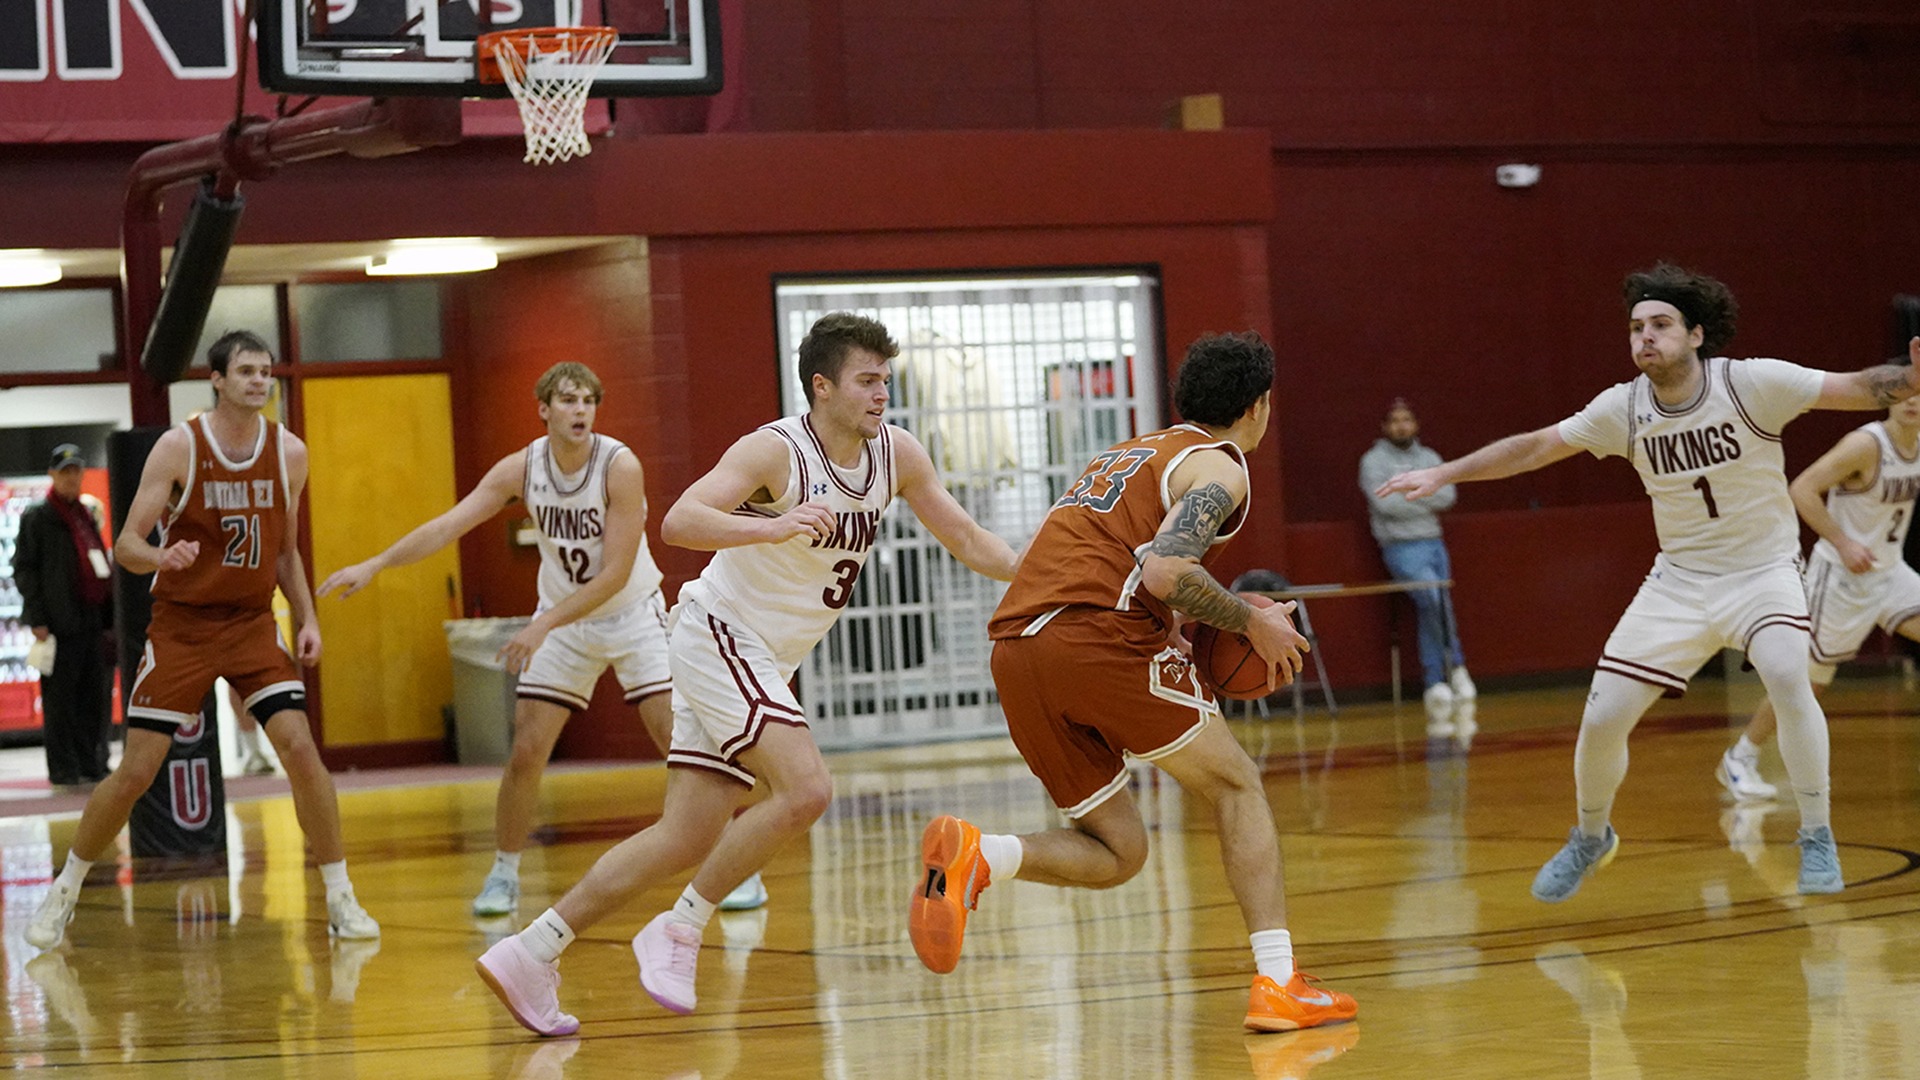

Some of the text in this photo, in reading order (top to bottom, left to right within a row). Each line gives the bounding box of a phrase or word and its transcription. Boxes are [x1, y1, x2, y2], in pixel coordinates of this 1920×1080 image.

[1643, 422, 1742, 476] VIKINGS
[1054, 448, 1157, 513] 33
[1692, 475, 1720, 519] 1
[221, 514, 261, 569] 21
[536, 505, 603, 541] VIKINGS
[558, 546, 594, 584] 12
[822, 559, 860, 609] 3
